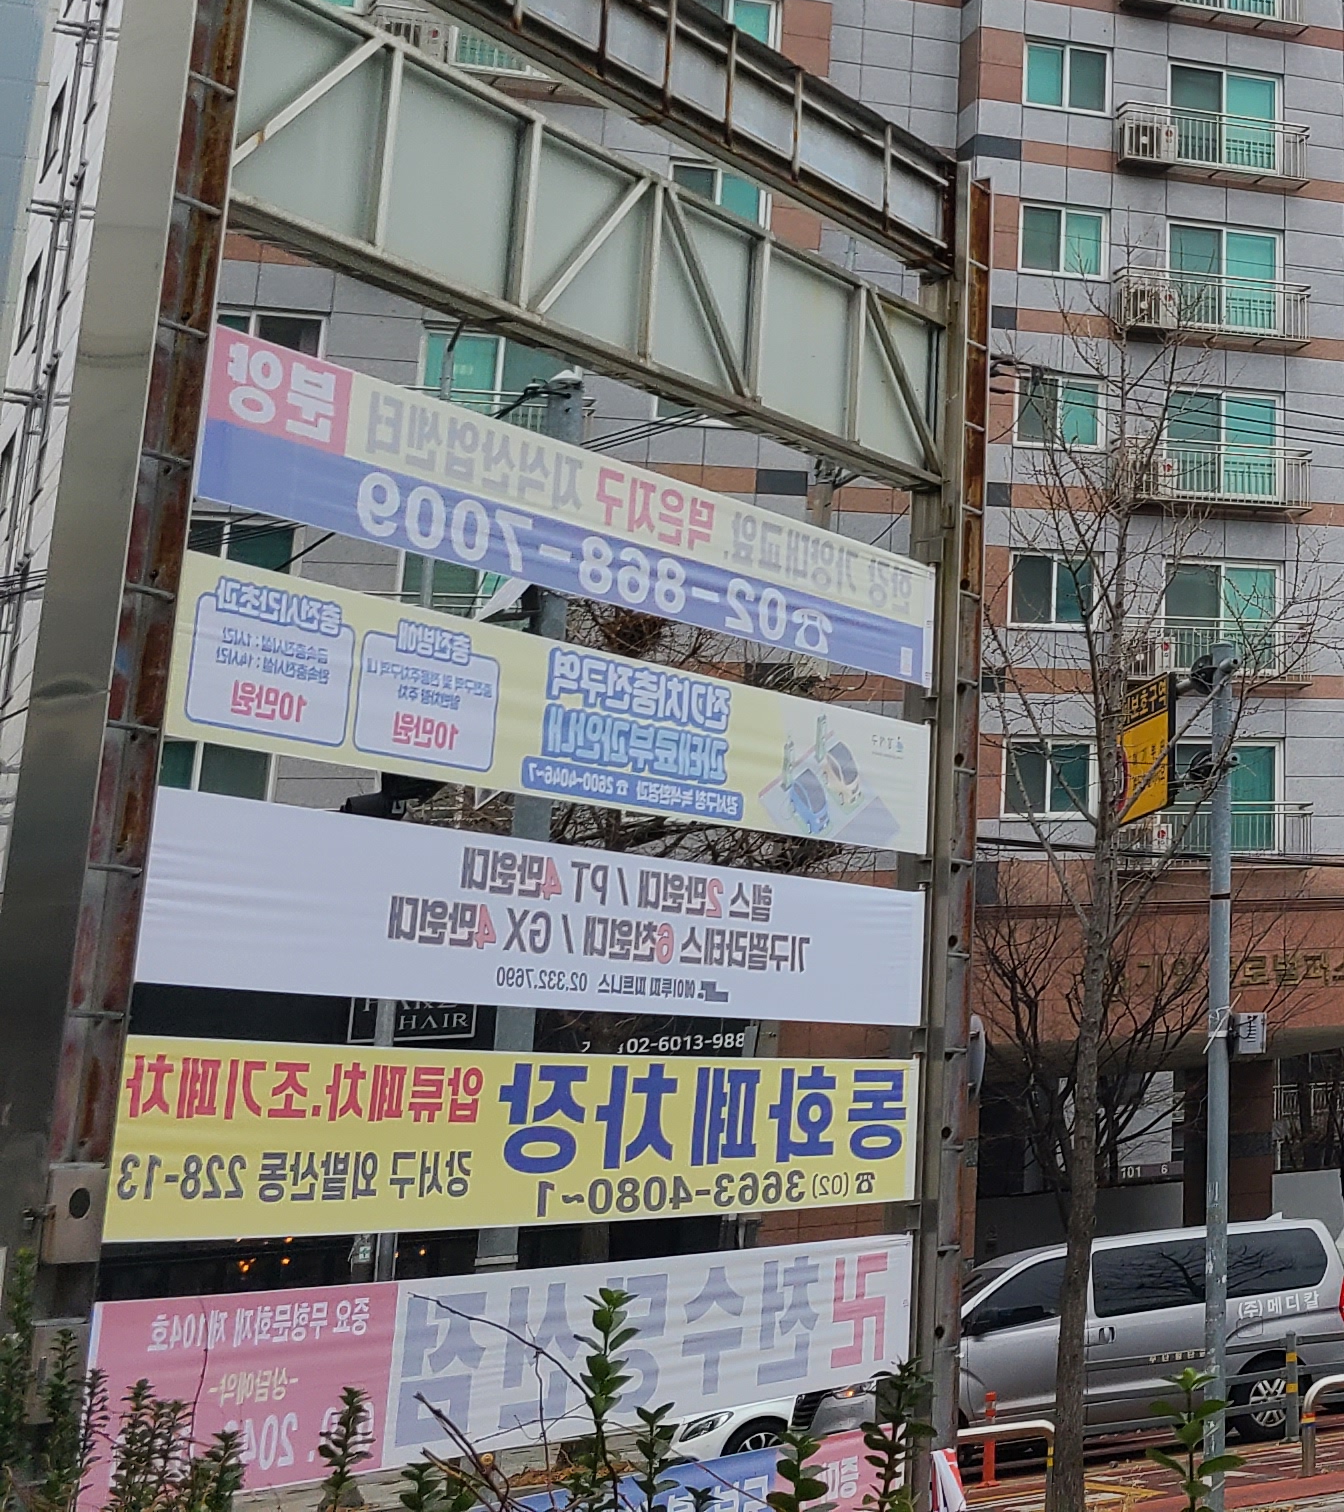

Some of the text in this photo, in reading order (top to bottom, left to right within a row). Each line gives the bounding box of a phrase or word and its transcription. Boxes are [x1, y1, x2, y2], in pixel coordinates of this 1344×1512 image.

[399, 1012, 470, 1031] HAIR
[1120, 1165, 1142, 1179] 101
[1237, 1291, 1321, 1319] (주)메디칼
